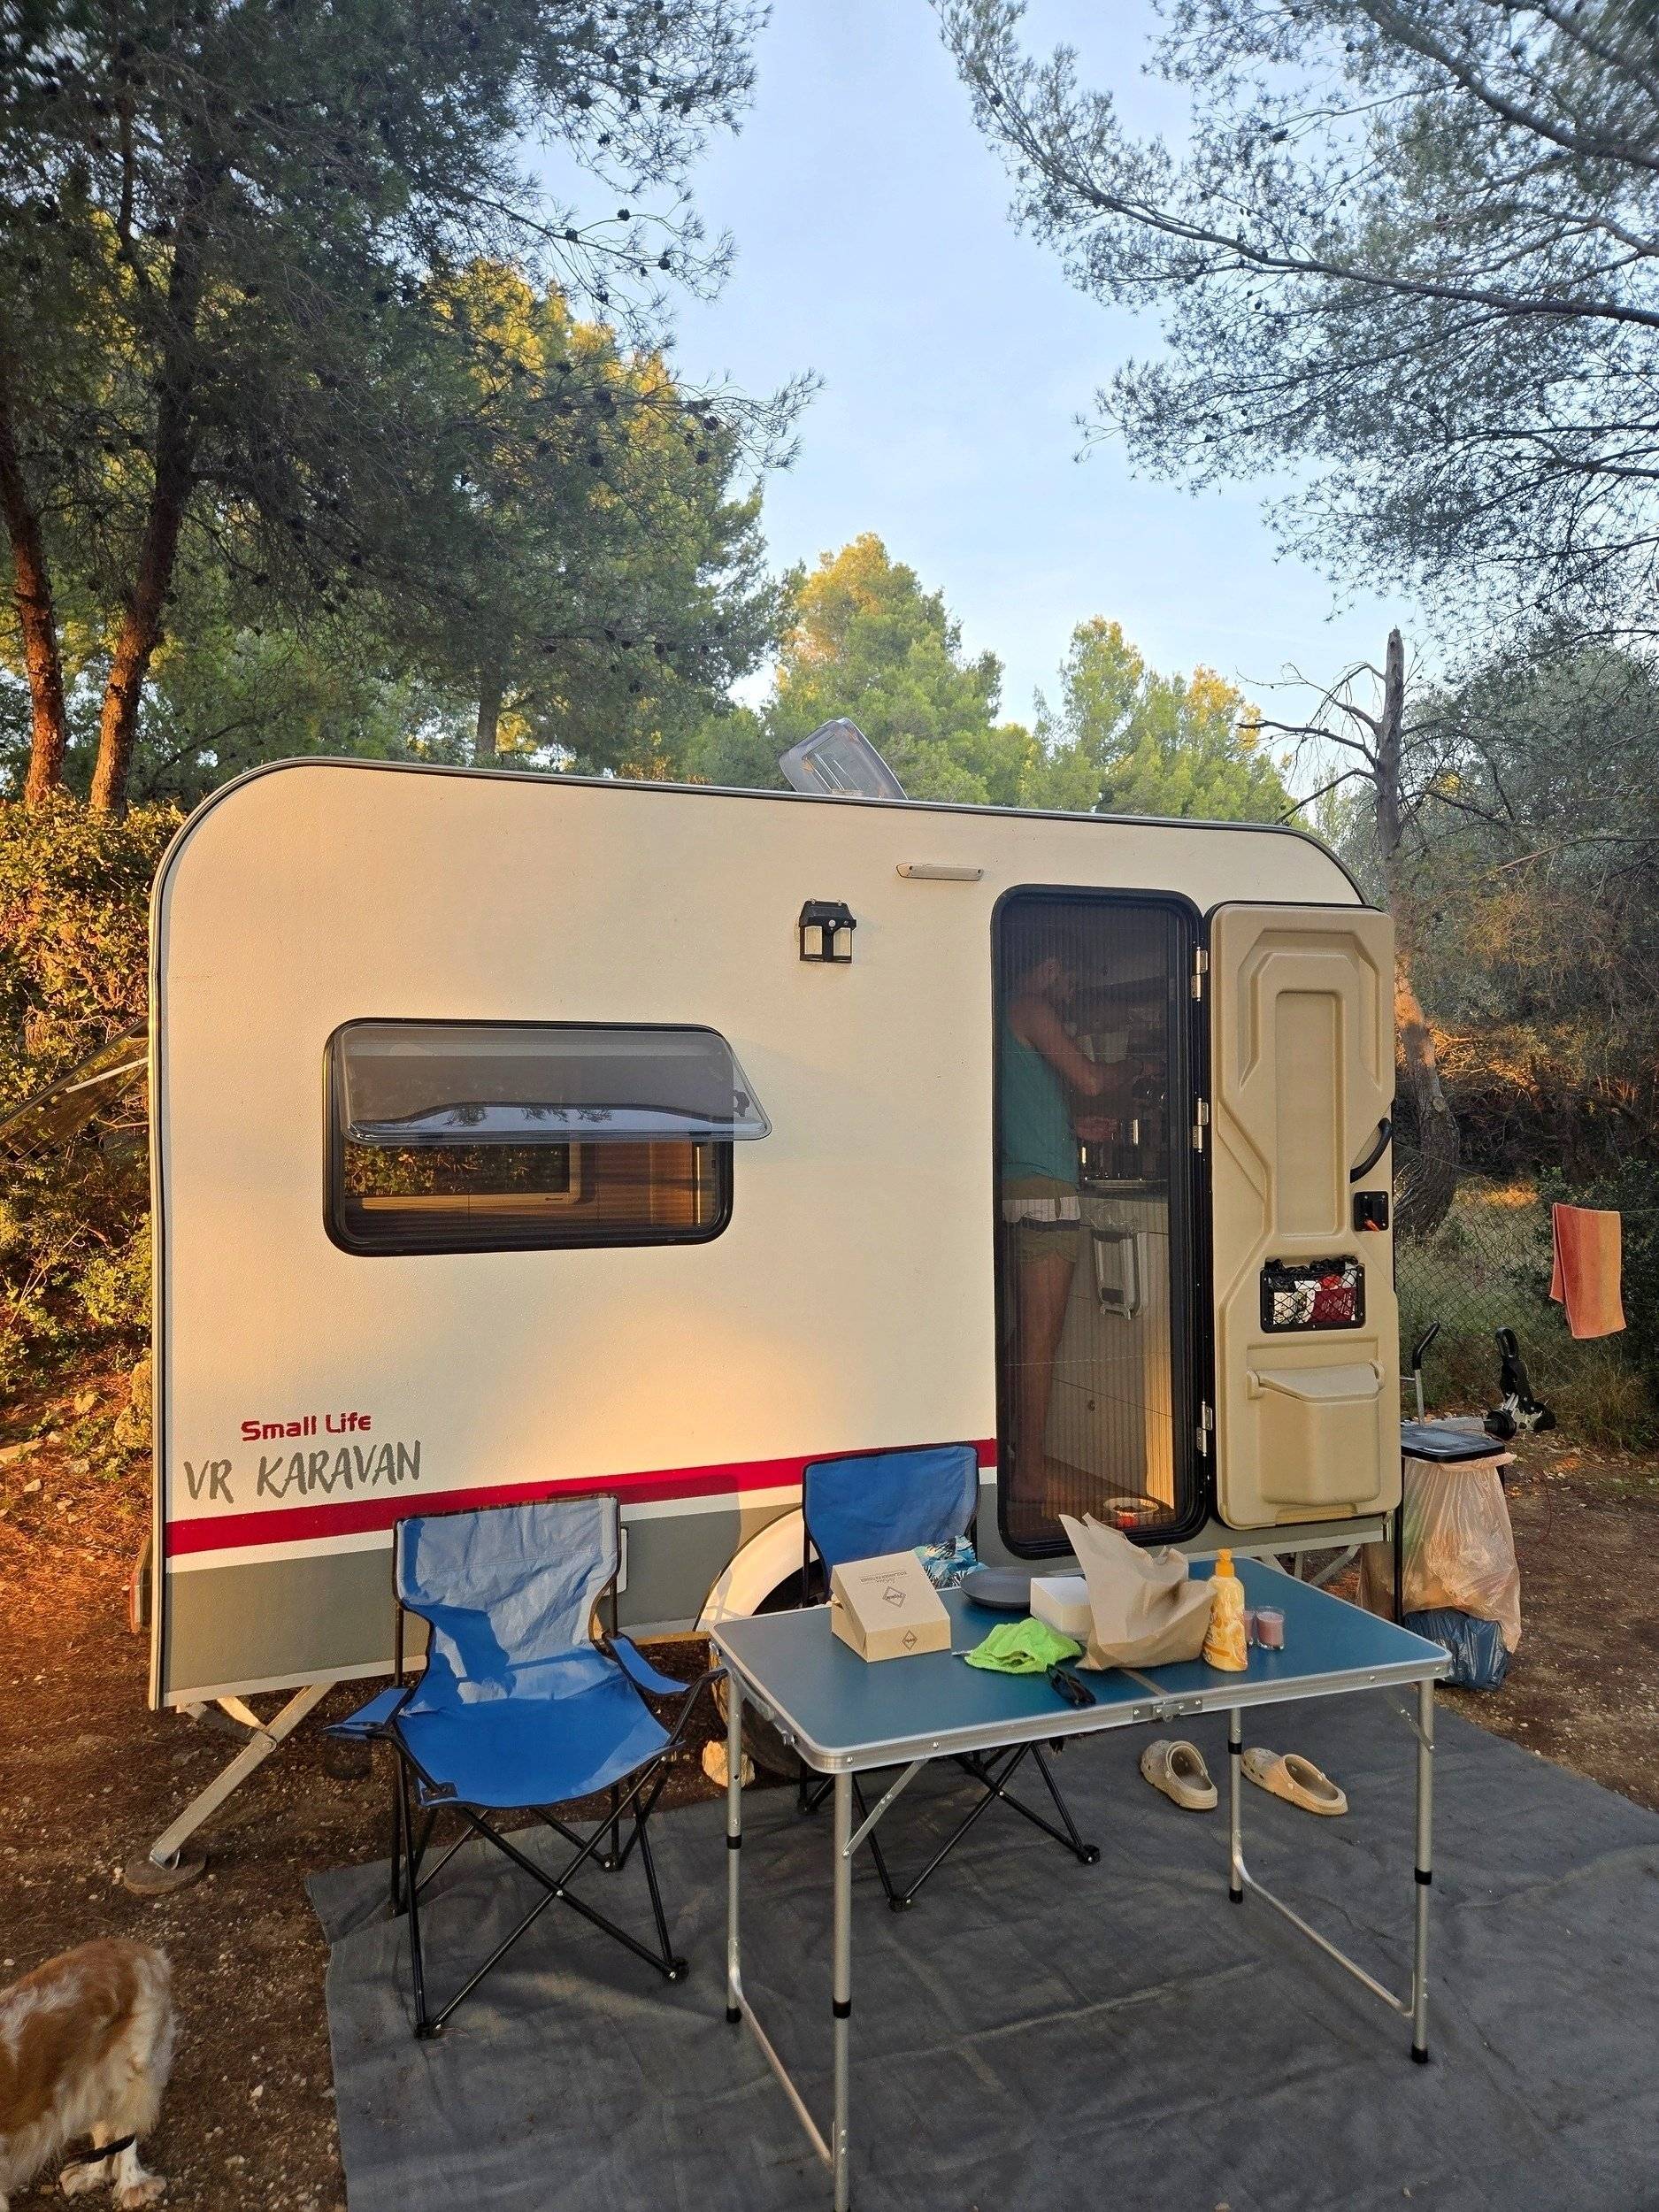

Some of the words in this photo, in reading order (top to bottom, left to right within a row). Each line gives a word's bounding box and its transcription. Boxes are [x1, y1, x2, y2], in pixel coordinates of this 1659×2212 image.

[241, 1415, 317, 1441] Small
[326, 1411, 372, 1433] Life
[183, 1458, 234, 1504] VR
[257, 1440, 421, 1499] KARAVAN
